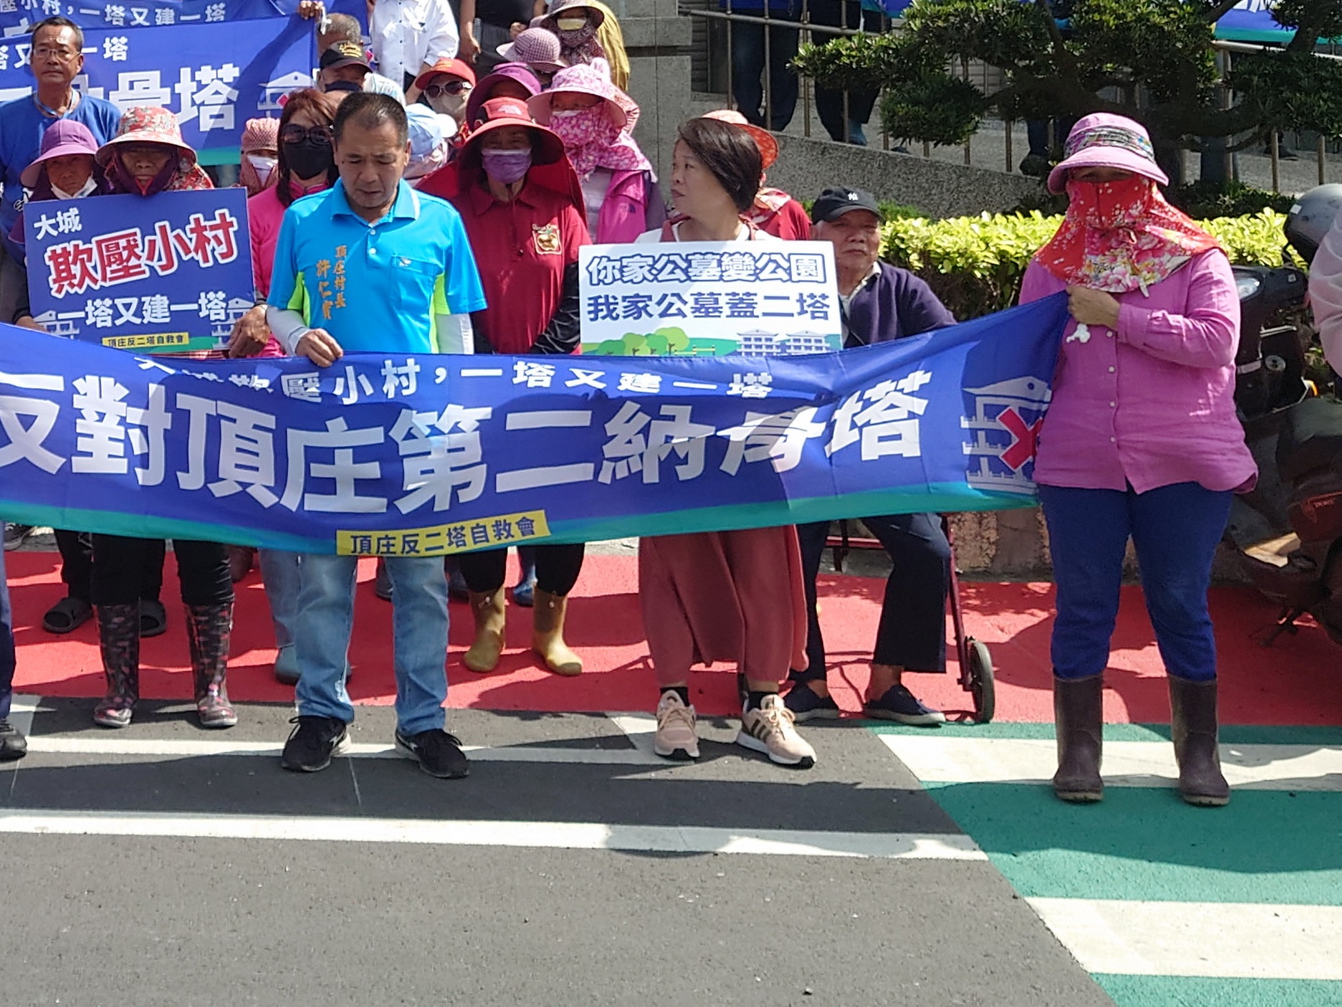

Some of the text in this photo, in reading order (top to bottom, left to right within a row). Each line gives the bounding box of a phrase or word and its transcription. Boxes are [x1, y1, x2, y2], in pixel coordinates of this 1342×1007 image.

[33, 207, 82, 240] 大城
[44, 209, 237, 297] 欺壓小村
[586, 252, 826, 285] 你家公墓變公園
[56, 291, 227, 328] 一塔又建一塔
[587, 292, 830, 321] 我家公墓蓋二塔
[350, 517, 535, 554] 頂庄反二塔自救會
